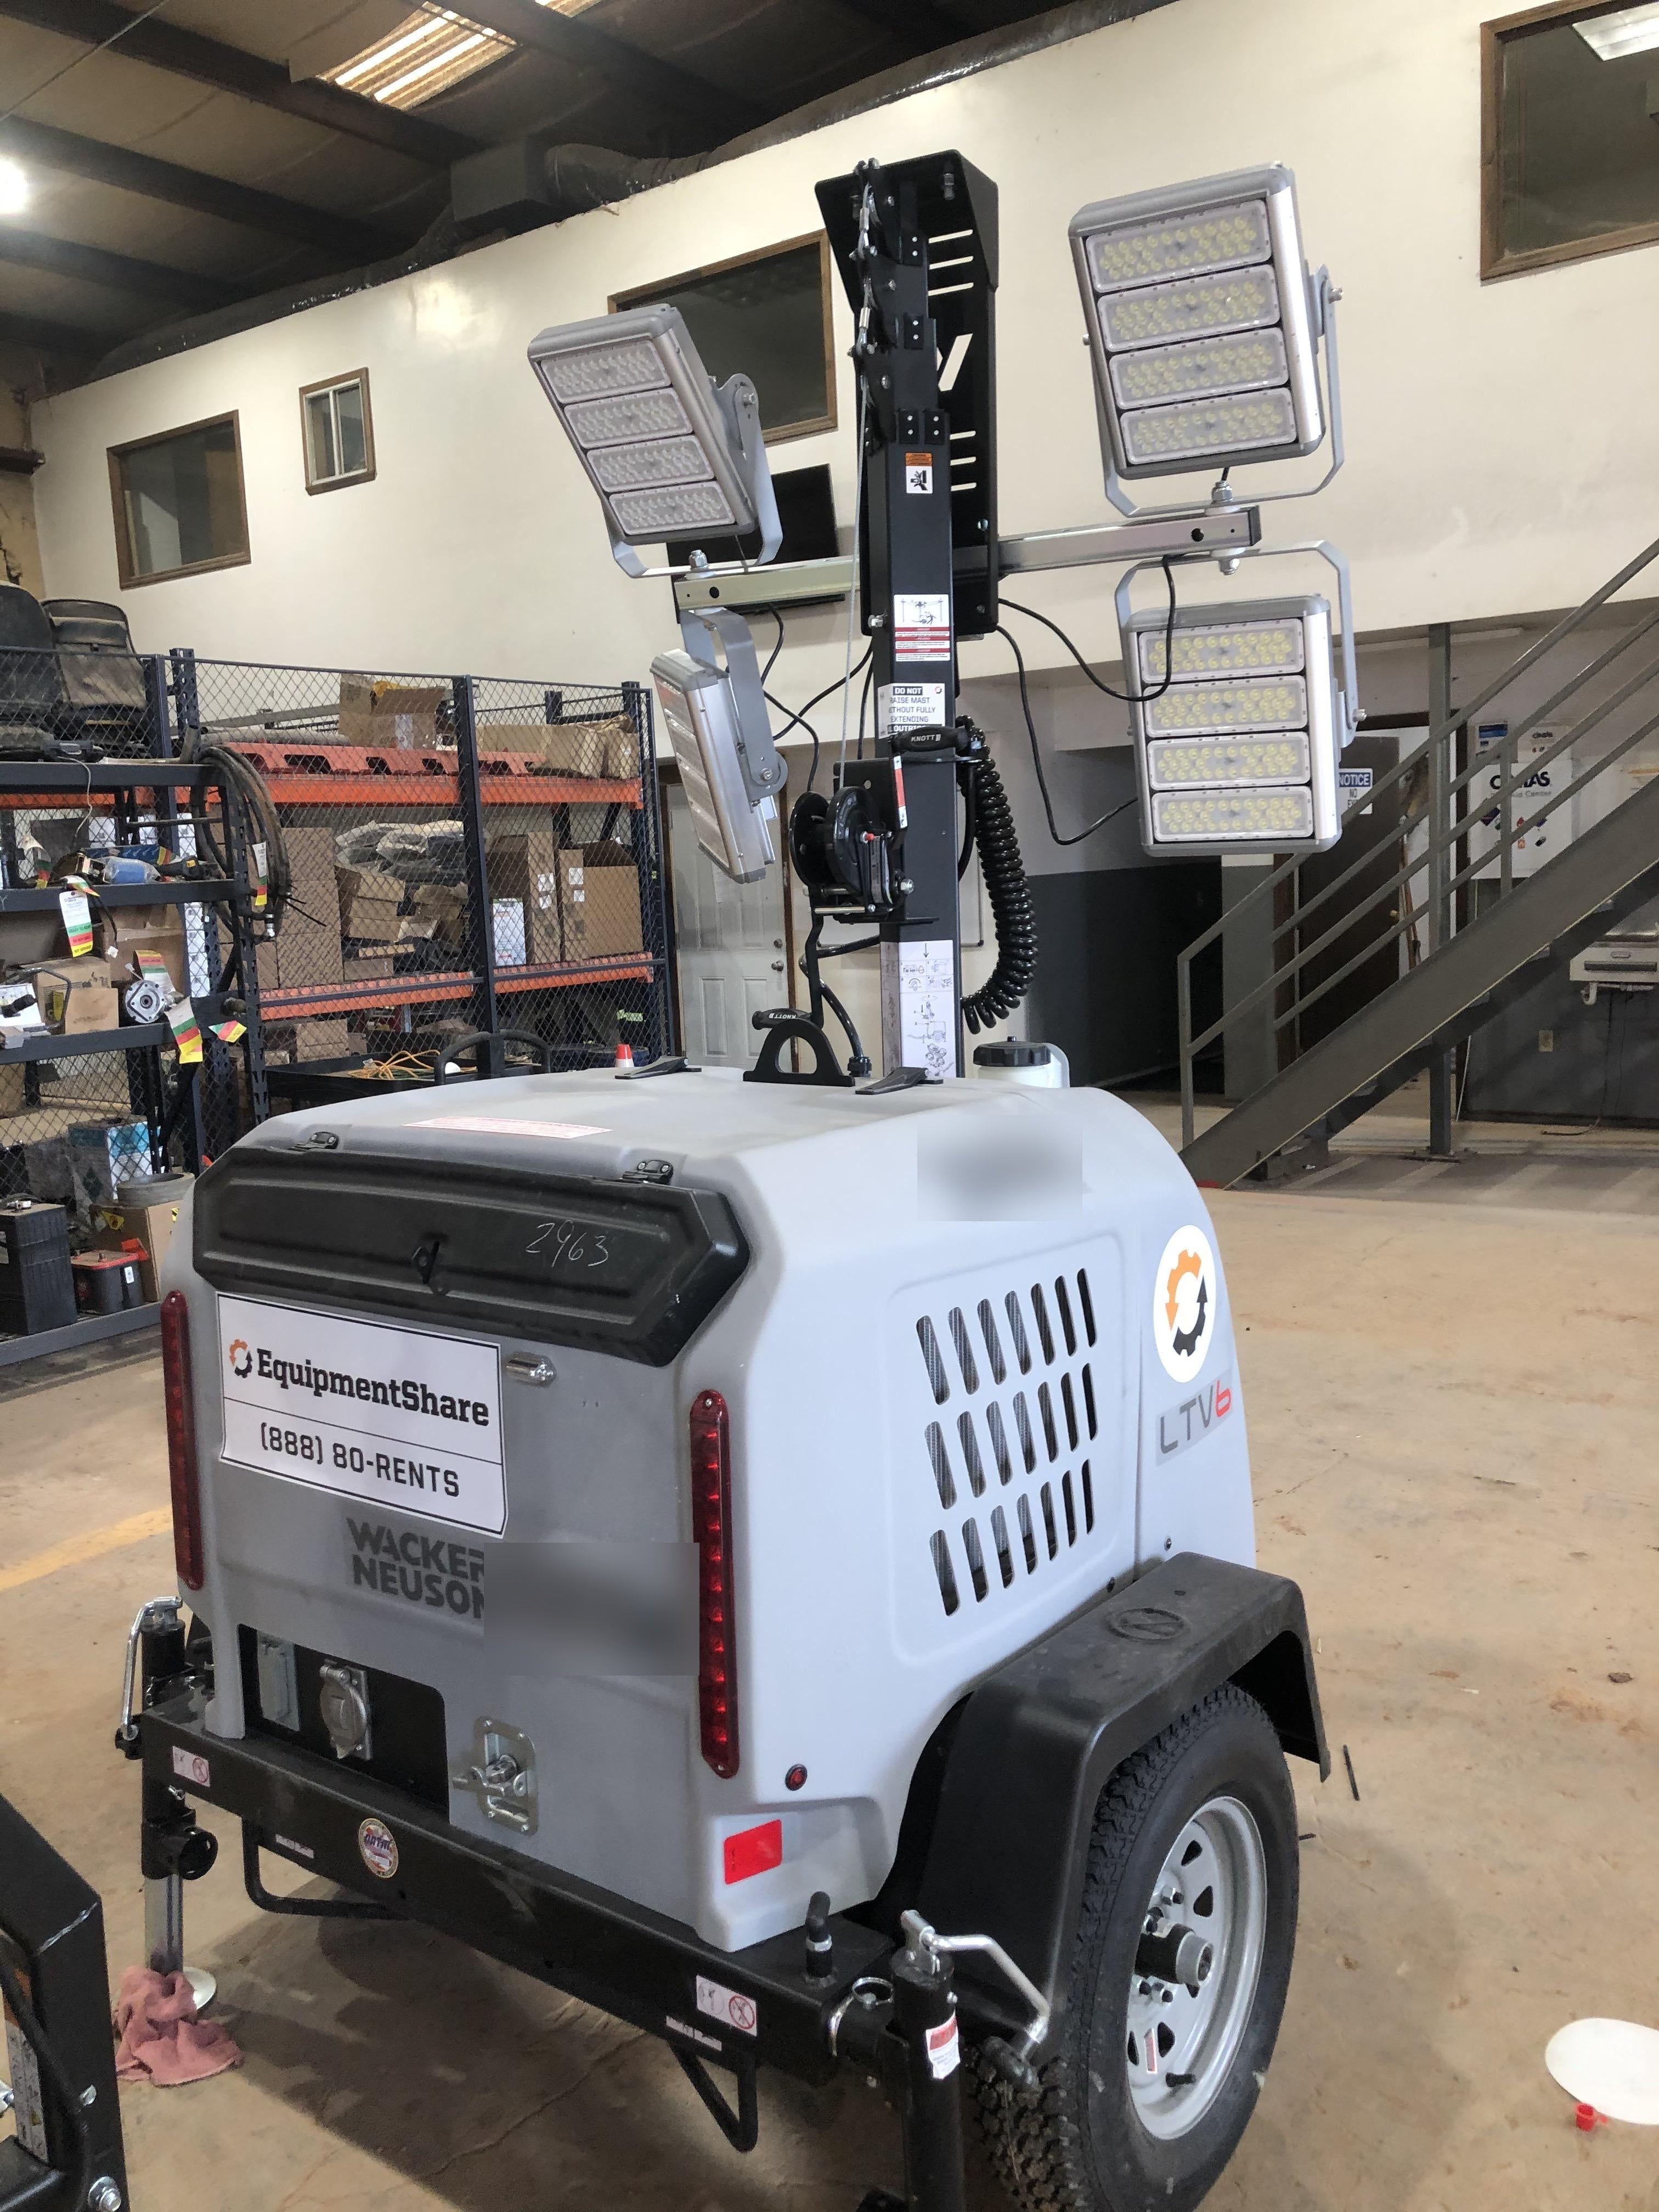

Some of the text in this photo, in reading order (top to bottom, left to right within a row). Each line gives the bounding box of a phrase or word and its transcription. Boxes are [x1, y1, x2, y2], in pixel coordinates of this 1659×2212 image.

[1339, 774, 1369, 786] NOTICE
[525, 1219, 609, 1268] 2963
[256, 1348, 489, 1426] EquipmentShare
[1160, 1380, 1231, 1454] LTV6
[261, 1422, 460, 1497] (888) 80-RENTS
[346, 1516, 484, 1583] WACKER
[352, 1553, 484, 1620] NEUSON
